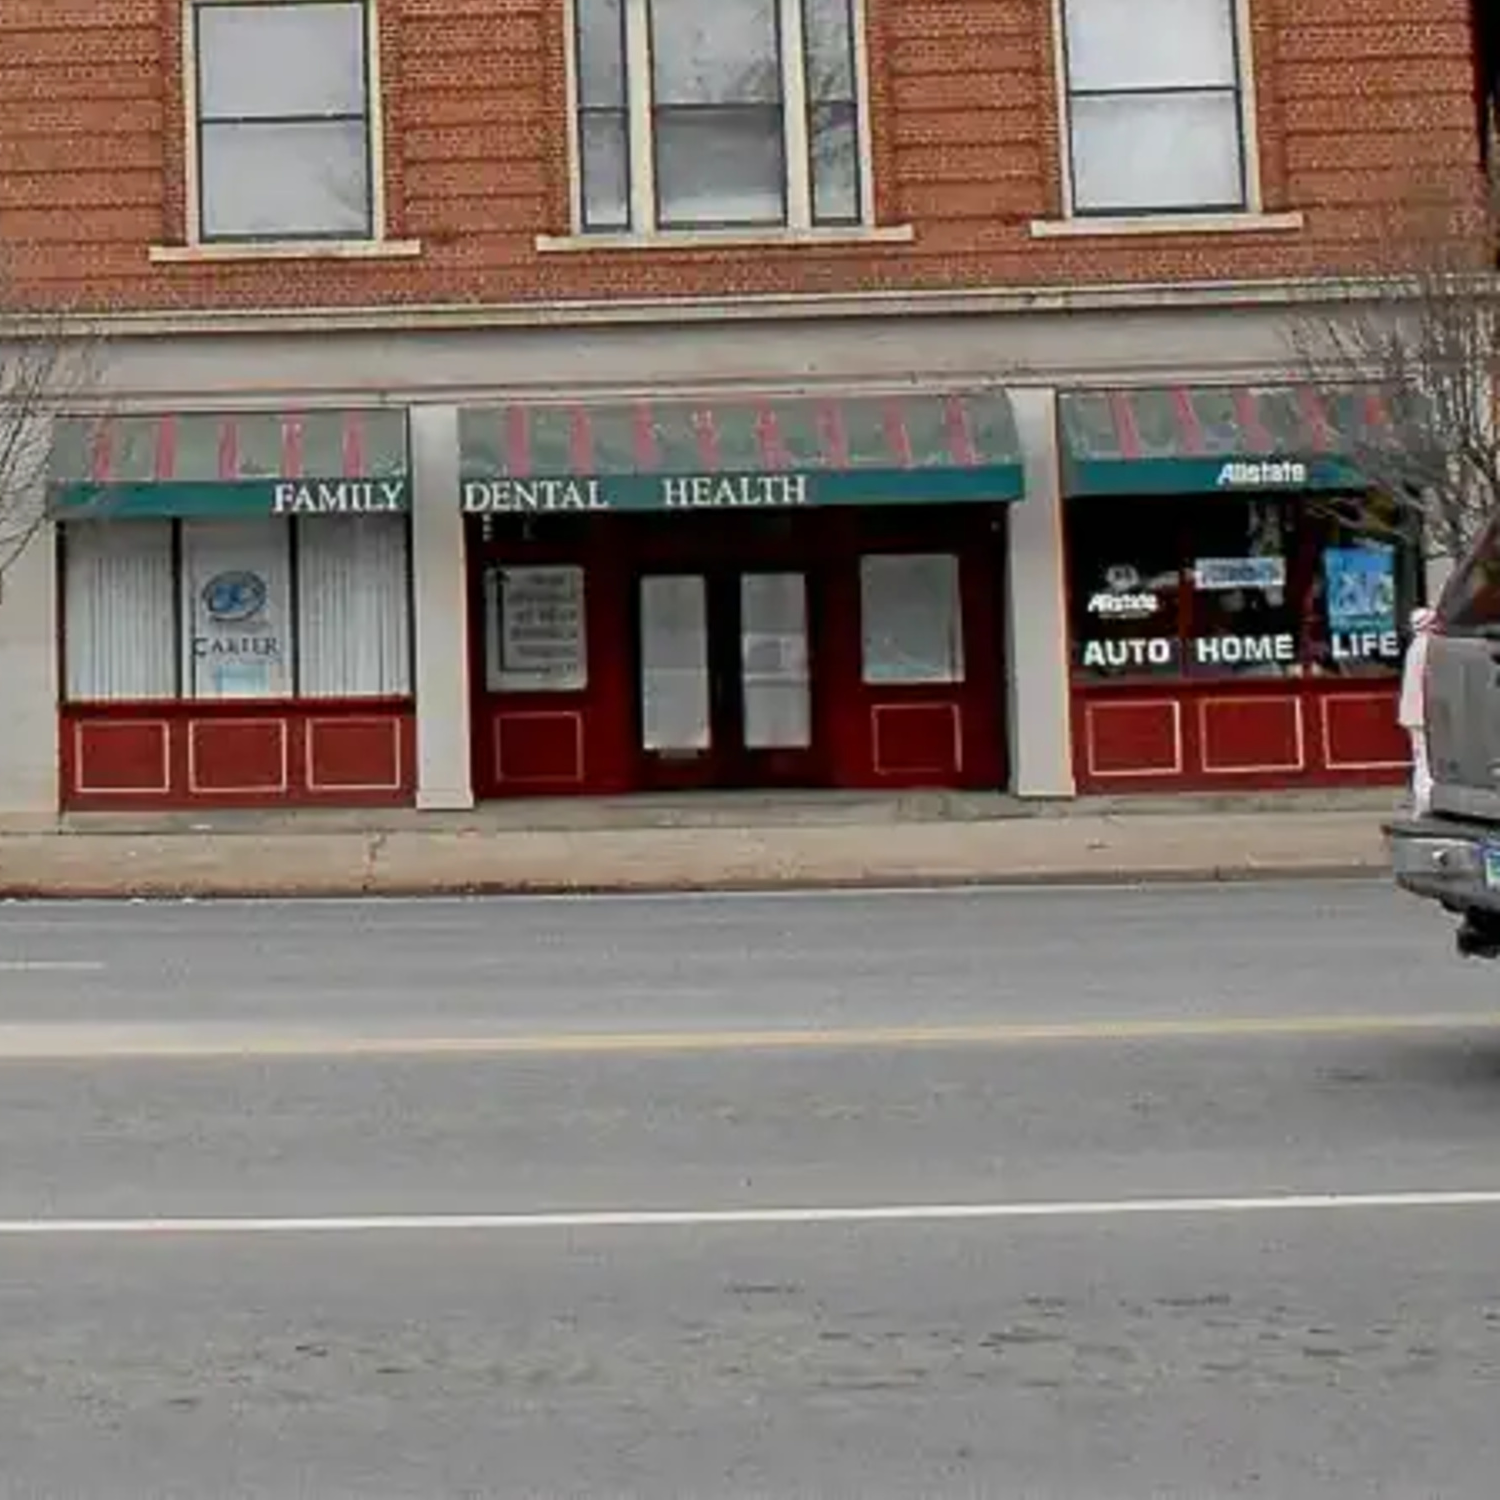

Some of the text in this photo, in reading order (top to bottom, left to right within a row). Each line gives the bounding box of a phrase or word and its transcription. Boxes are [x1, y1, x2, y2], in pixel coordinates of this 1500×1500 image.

[1217, 461, 1306, 484] Allstate
[273, 476, 807, 512] FAMILY DENTAL HEALTH
[1084, 630, 1400, 666] AUTO HOME LIFE
